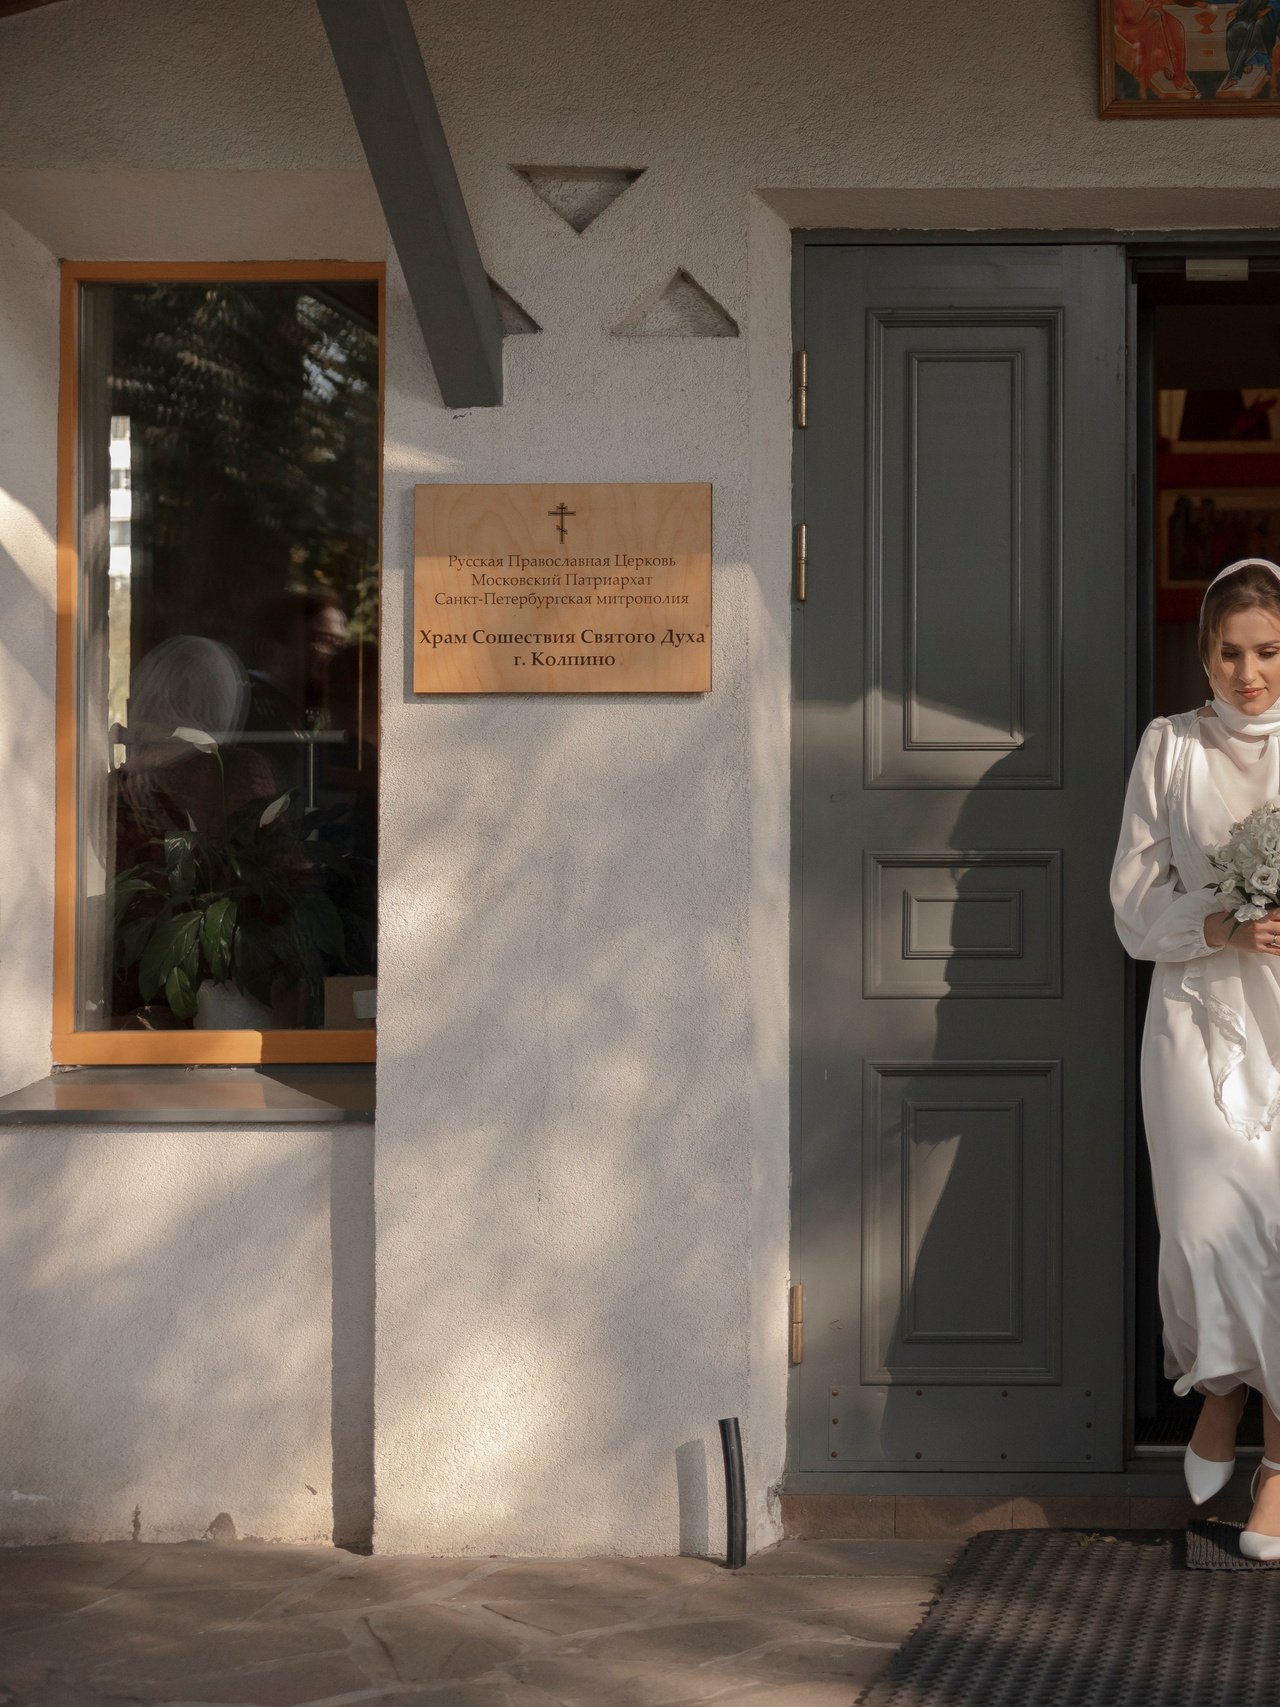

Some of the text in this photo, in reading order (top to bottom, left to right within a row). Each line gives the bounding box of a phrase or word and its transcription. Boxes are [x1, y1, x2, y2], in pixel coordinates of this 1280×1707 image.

[448, 554, 676, 572] Русская Православная Церковь
[471, 573, 653, 589] Московский Патриархат
[434, 592, 689, 609] Санкт-Петербургская митрополия
[420, 629, 705, 648] Храм Сошествия Святого Духа
[513, 651, 616, 666] г. Колпино
